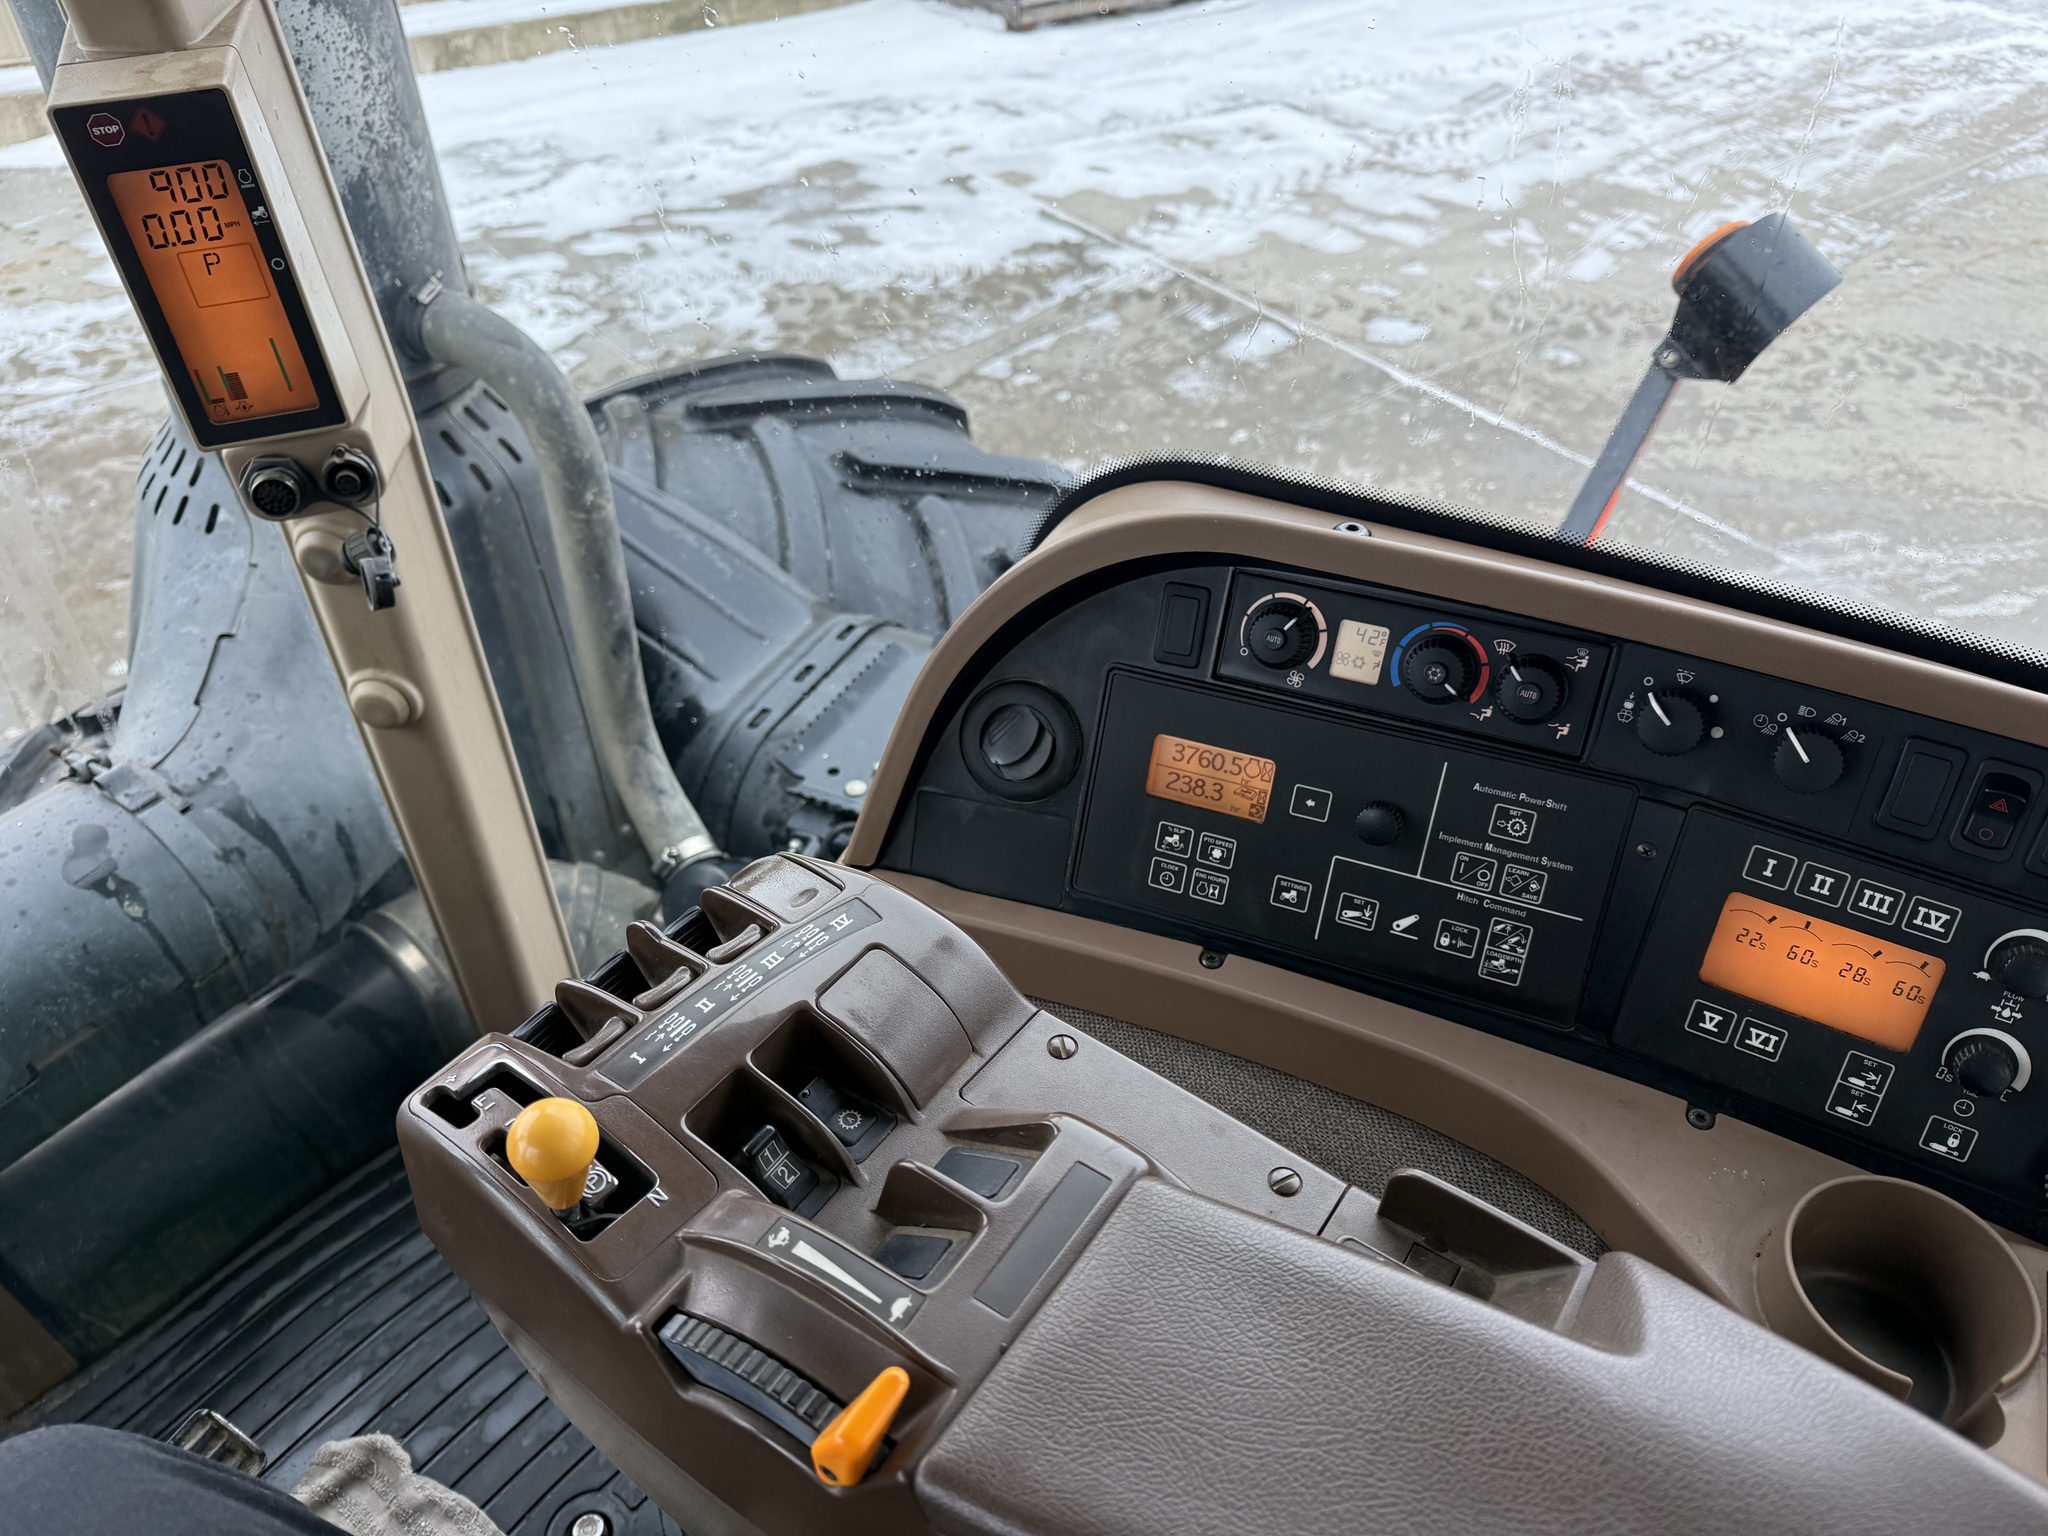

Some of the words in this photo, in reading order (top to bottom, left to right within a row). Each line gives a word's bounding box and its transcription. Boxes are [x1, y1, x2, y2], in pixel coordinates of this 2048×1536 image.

[92, 124, 120, 136] STOP
[149, 163, 229, 203] 900
[141, 206, 224, 249] 0.00
[224, 220, 241, 229] MPH
[202, 252, 221, 276] P
[1265, 634, 1281, 645] AUTO
[1519, 689, 1538, 700] AUTO
[1841, 717, 1848, 726] 1
[1857, 734, 1866, 744] 2
[1172, 743, 1243, 776] 3760.5
[1165, 771, 1224, 801] 238.3
[1240, 776, 1251, 786] hr
[1472, 782, 1517, 800] Automatic
[1230, 804, 1241, 813] hr
[1509, 809, 1522, 818] SET
[1203, 836, 1215, 844] PTO
[1215, 839, 1234, 849] SPEED
[1438, 831, 1483, 850] Implement
[1484, 842, 1540, 864] Management
[1540, 856, 1574, 872] System
[1160, 862, 1180, 872] CLOCK
[1508, 867, 1530, 877] LEARN
[1762, 858, 1778, 878] I
[1195, 871, 1208, 880] ENG
[1207, 874, 1227, 885] HOURS
[1476, 880, 1489, 889] OFF
[1809, 873, 1836, 896] II
[1280, 880, 1308, 892] SETTINGS
[1353, 898, 1365, 906] SET
[1521, 892, 1538, 901] SAVE
[1858, 888, 1895, 915] III
[1456, 891, 1479, 906] Hitch
[1483, 899, 1527, 918] Command
[829, 912, 854, 932] IV
[1912, 905, 1951, 933] IV
[1451, 925, 1469, 934] LOCK
[759, 951, 786, 970] III
[1486, 949, 1522, 965] LOAD/DEPTH
[694, 997, 717, 1014] II
[1698, 1010, 1724, 1033] V
[1744, 1027, 1780, 1053] VI
[629, 1051, 647, 1065] I
[1863, 1058, 1879, 1069] SET
[1850, 1088, 1865, 1099] SET
[1943, 1122, 1965, 1135] LOCK
[764, 1148, 775, 1164] 1
[776, 1166, 795, 1184] 2
[646, 1187, 669, 1207] N
